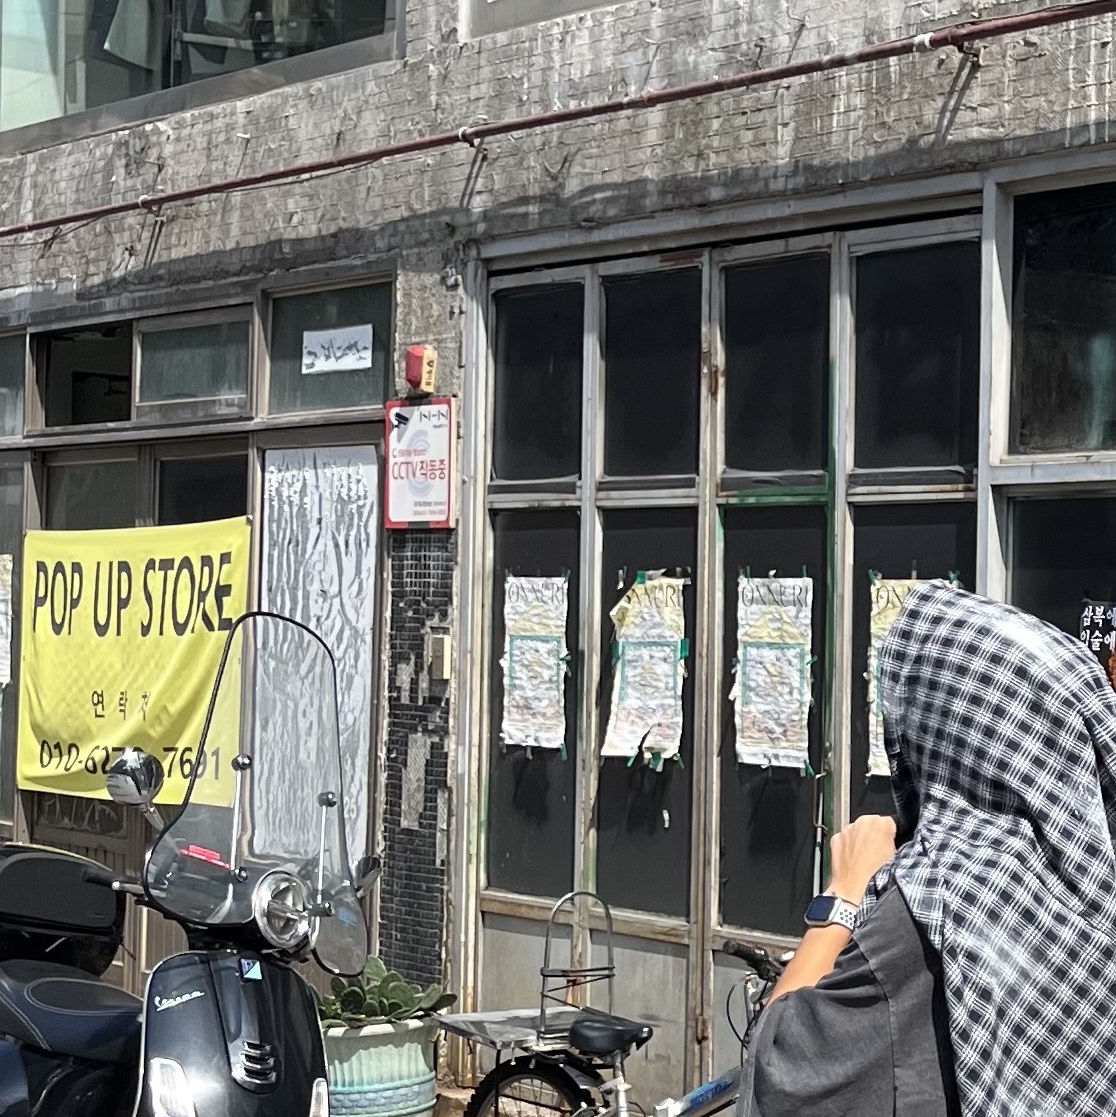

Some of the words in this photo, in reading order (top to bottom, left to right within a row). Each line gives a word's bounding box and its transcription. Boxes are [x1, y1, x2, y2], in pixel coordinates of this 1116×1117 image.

[33, 559, 84, 637] POP
[93, 559, 133, 638] UP
[140, 550, 234, 638] STORE
